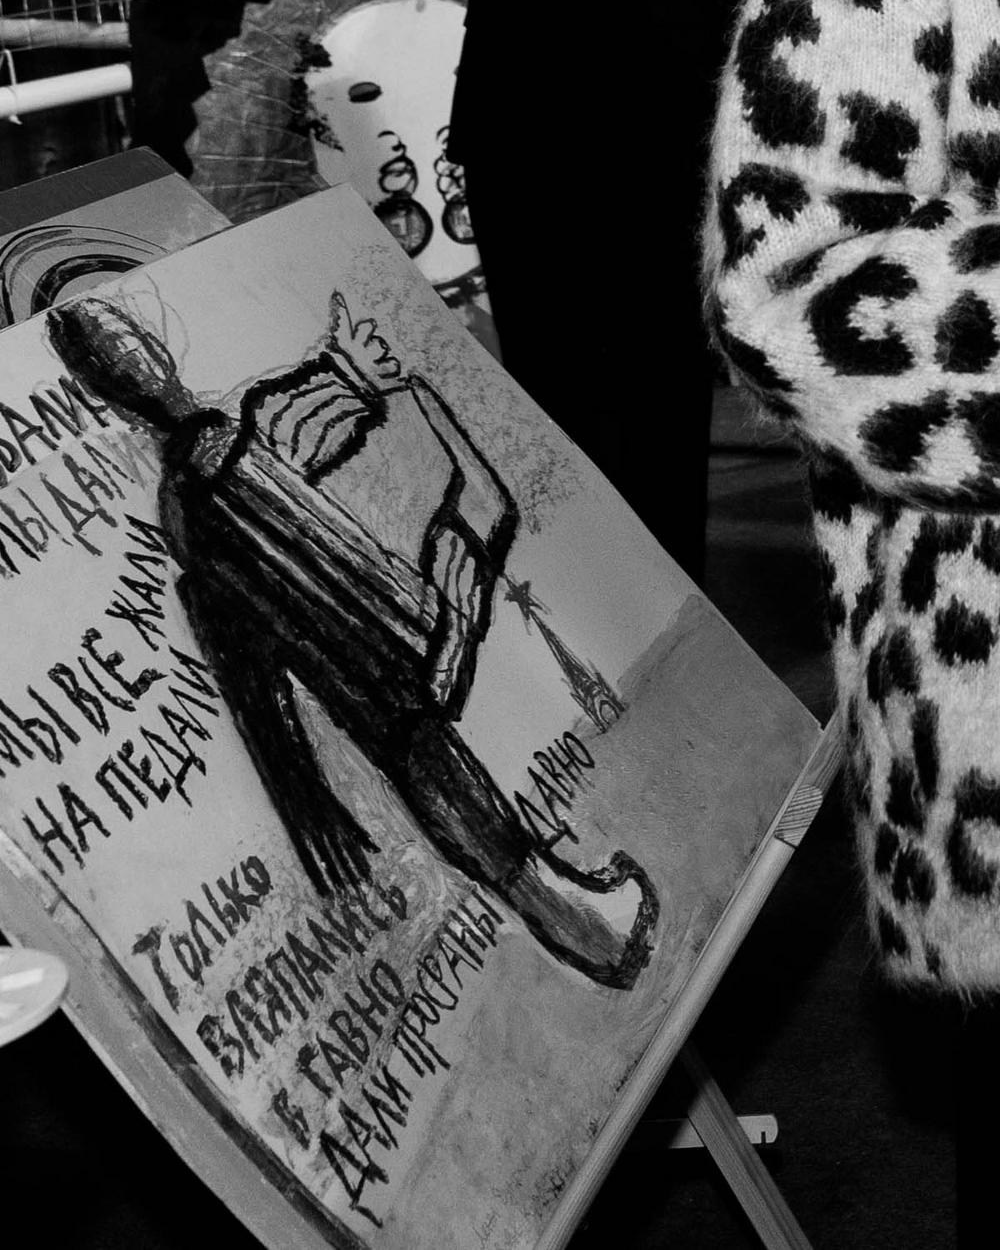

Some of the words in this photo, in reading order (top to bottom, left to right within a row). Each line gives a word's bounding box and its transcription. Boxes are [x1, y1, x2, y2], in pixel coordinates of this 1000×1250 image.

[105, 513, 170, 651] ЖАЛИ
[22, 782, 111, 874] НА
[95, 644, 220, 822] ПЕДАЛИ
[48, 628, 168, 736] ВСЕ
[132, 855, 274, 1015] ТОЛЬКО
[196, 881, 408, 1079] ВЛЯПАЛИСЬ
[319, 1061, 413, 1229] ДАЛИ
[391, 887, 505, 1079] ПРОСРАНЫ
[513, 731, 596, 848] ДАВНО
[272, 1087, 310, 1150] В
[298, 958, 405, 1100] ГАВНО
